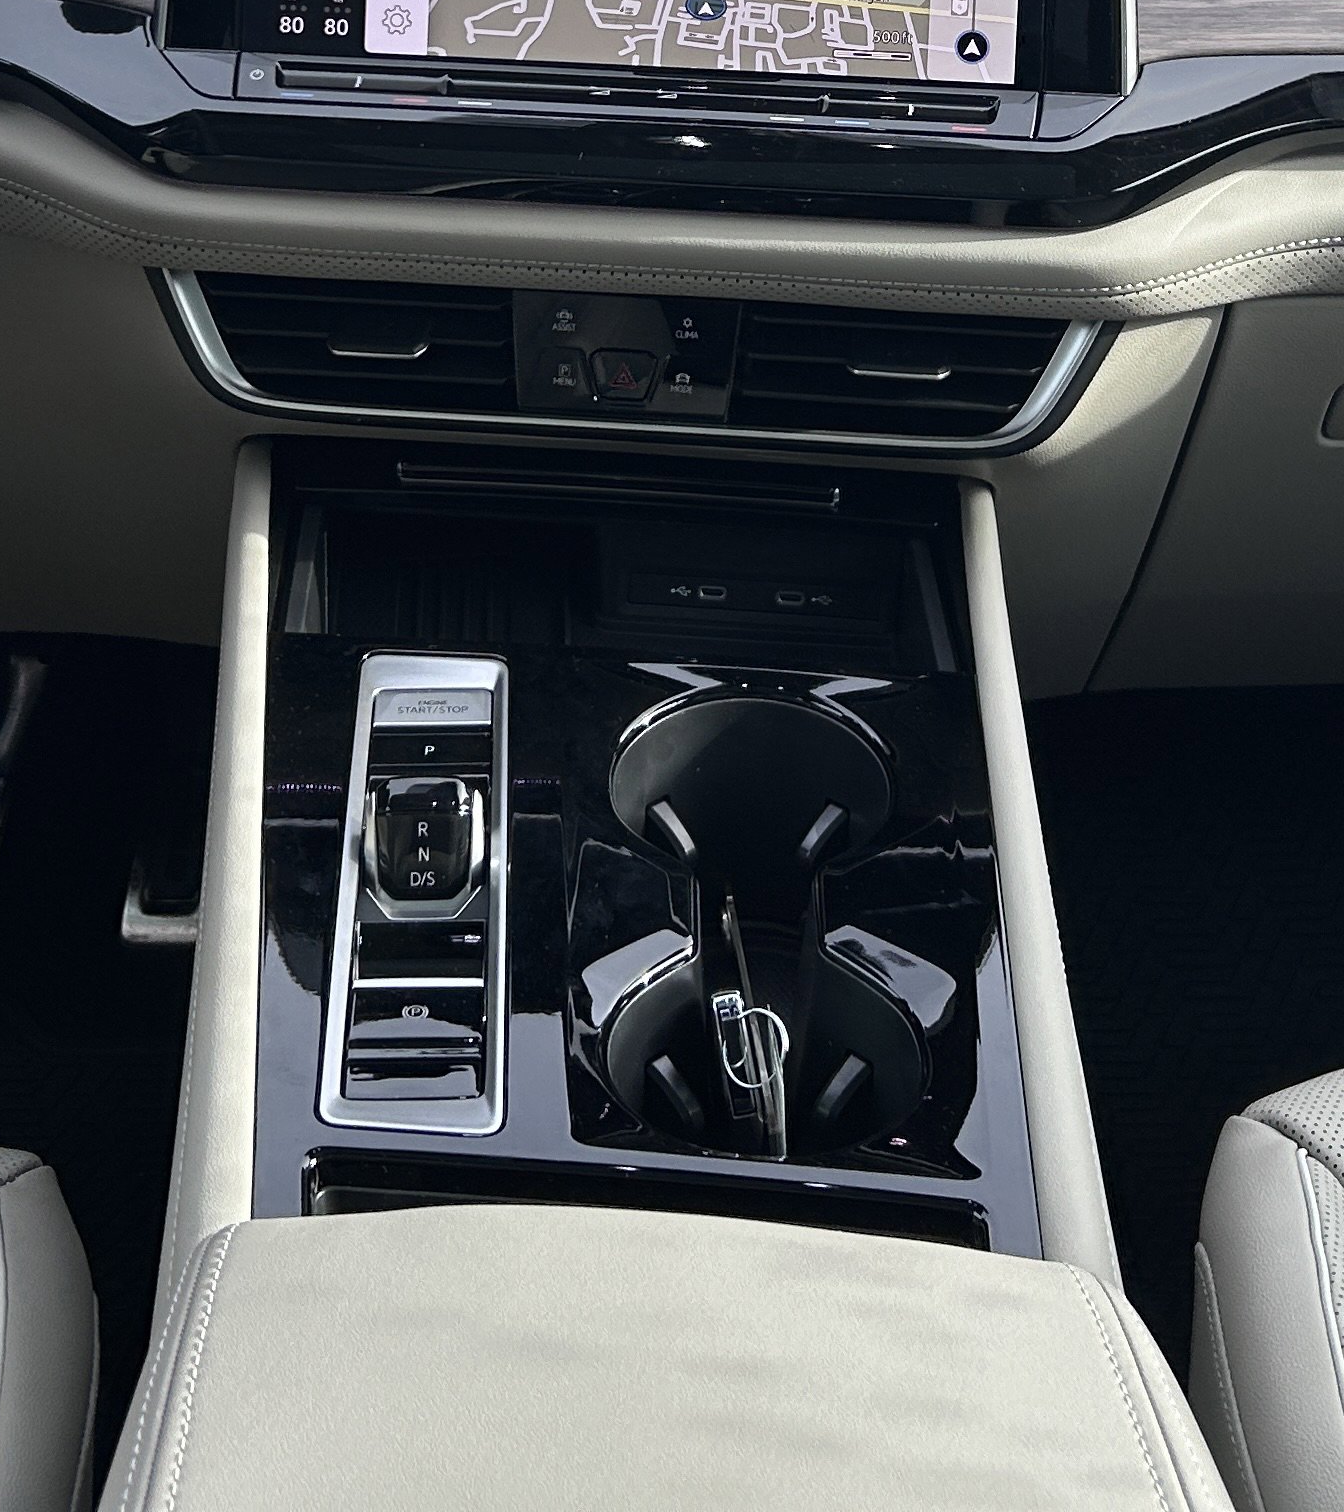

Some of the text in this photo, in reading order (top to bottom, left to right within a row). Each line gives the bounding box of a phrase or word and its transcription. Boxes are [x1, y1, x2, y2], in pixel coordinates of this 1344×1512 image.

[279, 16, 304, 35] 80
[323, 18, 349, 36] 80
[397, 705, 470, 715] START/STOP
[424, 745, 436, 756] P
[418, 821, 428, 838] R
[418, 846, 430, 863] N
[410, 870, 436, 887] D/S
